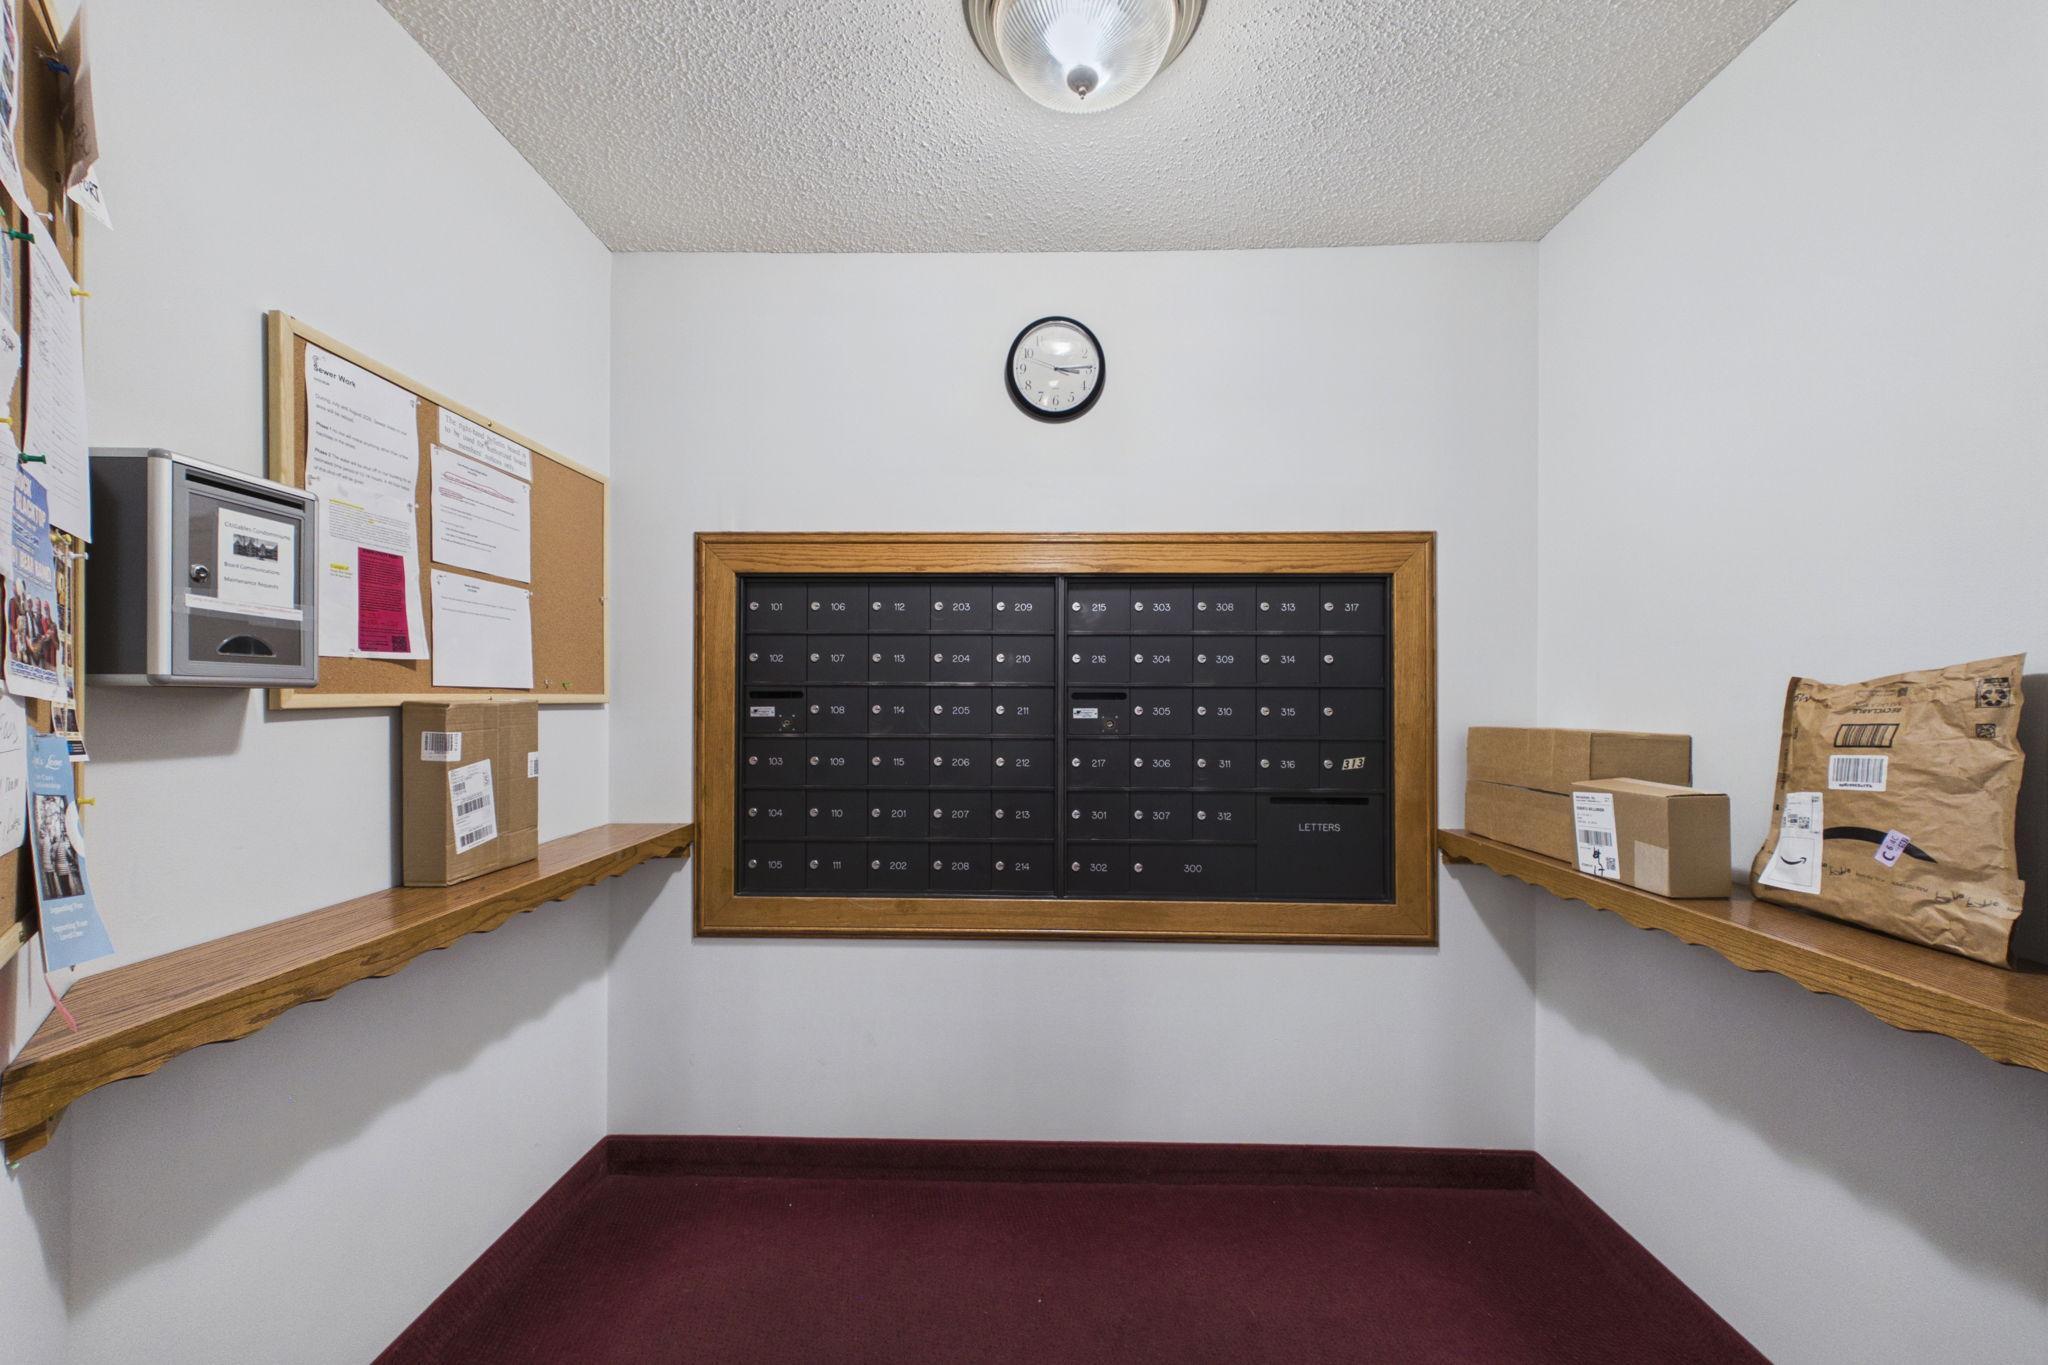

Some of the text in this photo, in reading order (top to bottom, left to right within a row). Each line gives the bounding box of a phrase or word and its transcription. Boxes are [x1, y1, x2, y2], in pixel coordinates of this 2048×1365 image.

[1024, 348, 1034, 359] 10
[1081, 348, 1088, 359] 2
[1019, 363, 1027, 374] 9
[338, 374, 356, 388] Work
[1024, 379, 1032, 390] 8
[1080, 379, 1087, 391] 4
[1037, 391, 1044, 402] 7
[1052, 394, 1060, 406] 6
[1067, 391, 1075, 403] 5
[770, 602, 783, 612] 101
[830, 602, 846, 612] 106
[894, 602, 905, 612] 112
[952, 602, 971, 612] 203
[1014, 602, 1033, 612] 209
[1091, 603, 1107, 613] 215
[1152, 603, 1171, 613] 303
[1215, 602, 1234, 612] 308
[1280, 602, 1296, 612] 313
[1344, 603, 1360, 613] 317
[769, 653, 784, 663] 102
[830, 653, 846, 663] 107
[893, 654, 906, 664] 113
[952, 654, 970, 664] 204
[1015, 654, 1031, 664] 210
[1091, 654, 1107, 664] 216
[1152, 654, 1171, 664] 304
[1215, 655, 1234, 665] 309
[1280, 655, 1296, 665] 314
[830, 705, 846, 715] 108
[893, 705, 905, 715] 114
[952, 706, 970, 716] 205
[1017, 706, 1029, 716] 211
[1152, 706, 1171, 716] 305
[1217, 707, 1233, 717] 310
[1280, 707, 1296, 717] 315
[768, 756, 784, 766] 103
[829, 757, 845, 767] 109
[893, 757, 905, 767] 115
[951, 758, 970, 768] 206
[1015, 758, 1030, 768] 212
[1091, 758, 1106, 768] 217
[1152, 759, 1171, 769] 306
[1218, 759, 1231, 769] 311
[1280, 760, 1296, 770] 316
[1343, 757, 1364, 769] 313
[768, 808, 783, 818] 104
[831, 808, 844, 818] 110
[891, 809, 907, 819] 201
[951, 809, 970, 819] 207
[1015, 810, 1031, 820] 213
[1091, 810, 1107, 820] 301
[1152, 811, 1171, 821] 307
[1216, 811, 1232, 821] 312
[1298, 822, 1341, 832] LETTERS
[767, 860, 783, 870] 105
[832, 861, 842, 871] 111
[889, 861, 908, 871] 202
[951, 861, 970, 871] 208
[1015, 862, 1030, 872] 214
[1089, 863, 1108, 873] 302
[1183, 863, 1203, 873] 300
